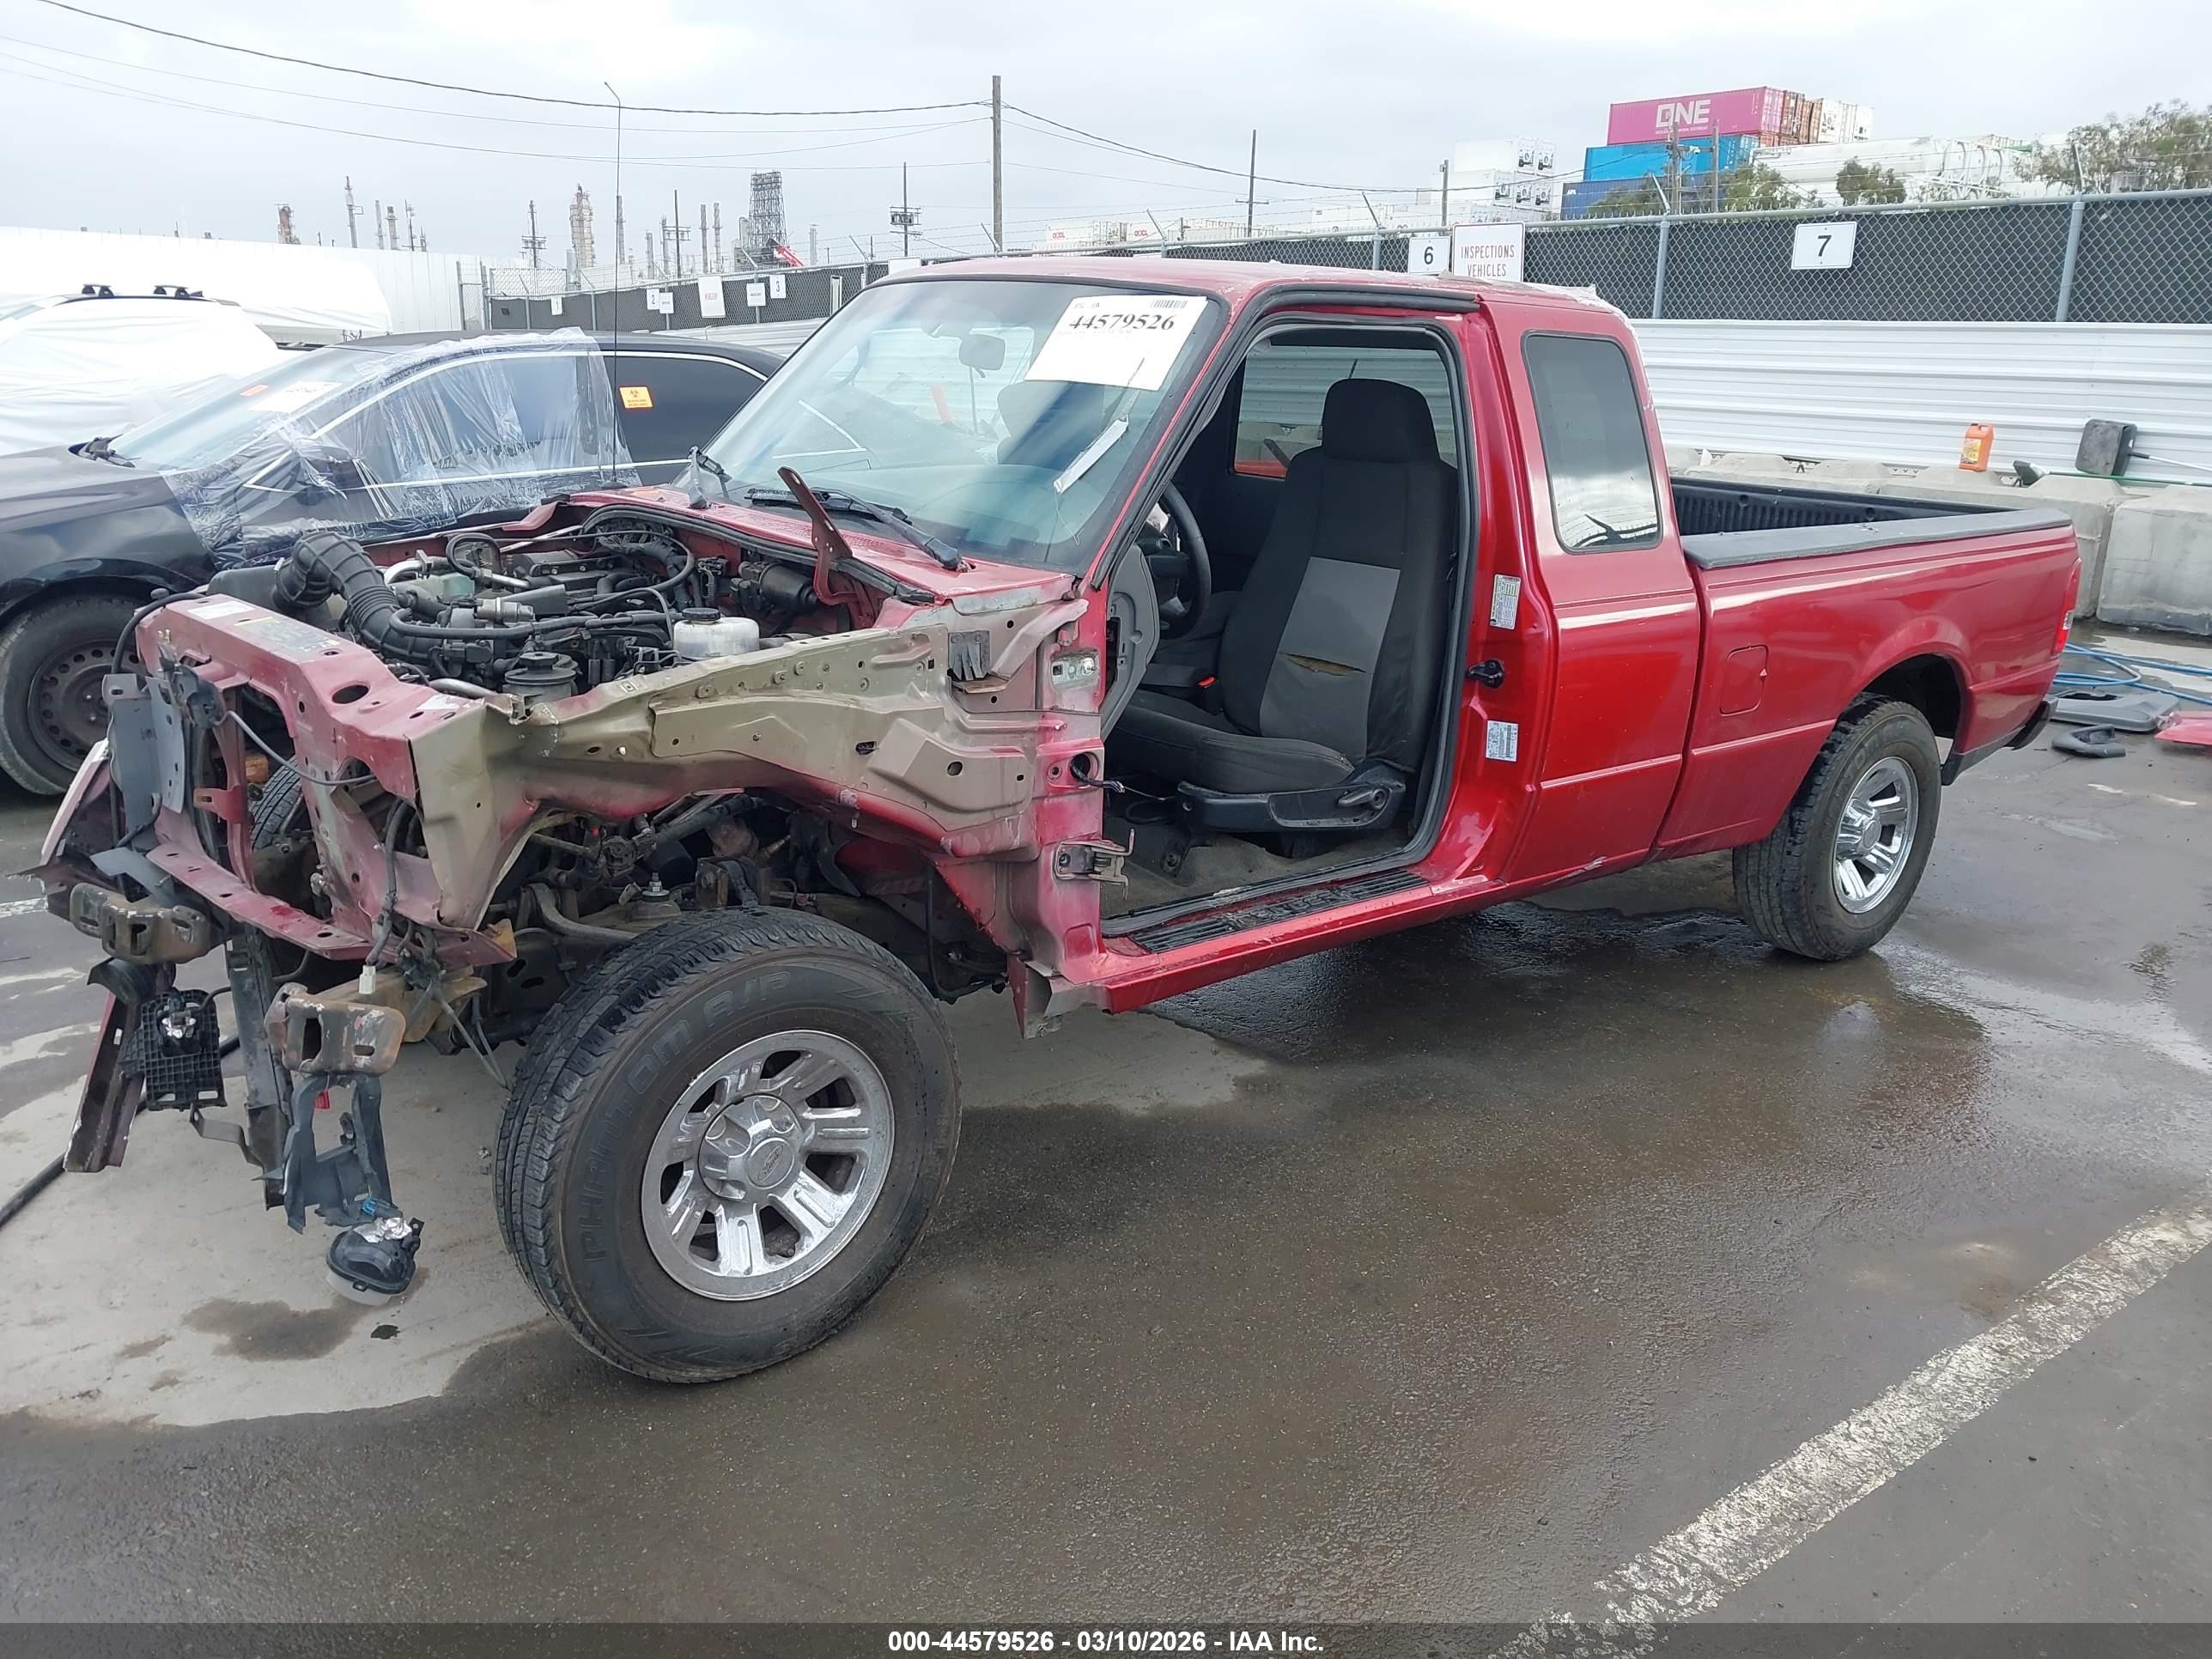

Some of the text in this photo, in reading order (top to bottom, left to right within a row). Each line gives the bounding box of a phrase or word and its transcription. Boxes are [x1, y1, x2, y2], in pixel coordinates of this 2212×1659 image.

[1656, 99, 1711, 128] ONE
[1461, 244, 1515, 259] INSPECTIONS
[1817, 234, 1832, 258] 7
[1424, 246, 1434, 265] 6
[1467, 263, 1507, 277] VEHICLES
[775, 280, 781, 293] 3
[651, 294, 655, 305] 2
[1069, 313, 1176, 331] 44579526
